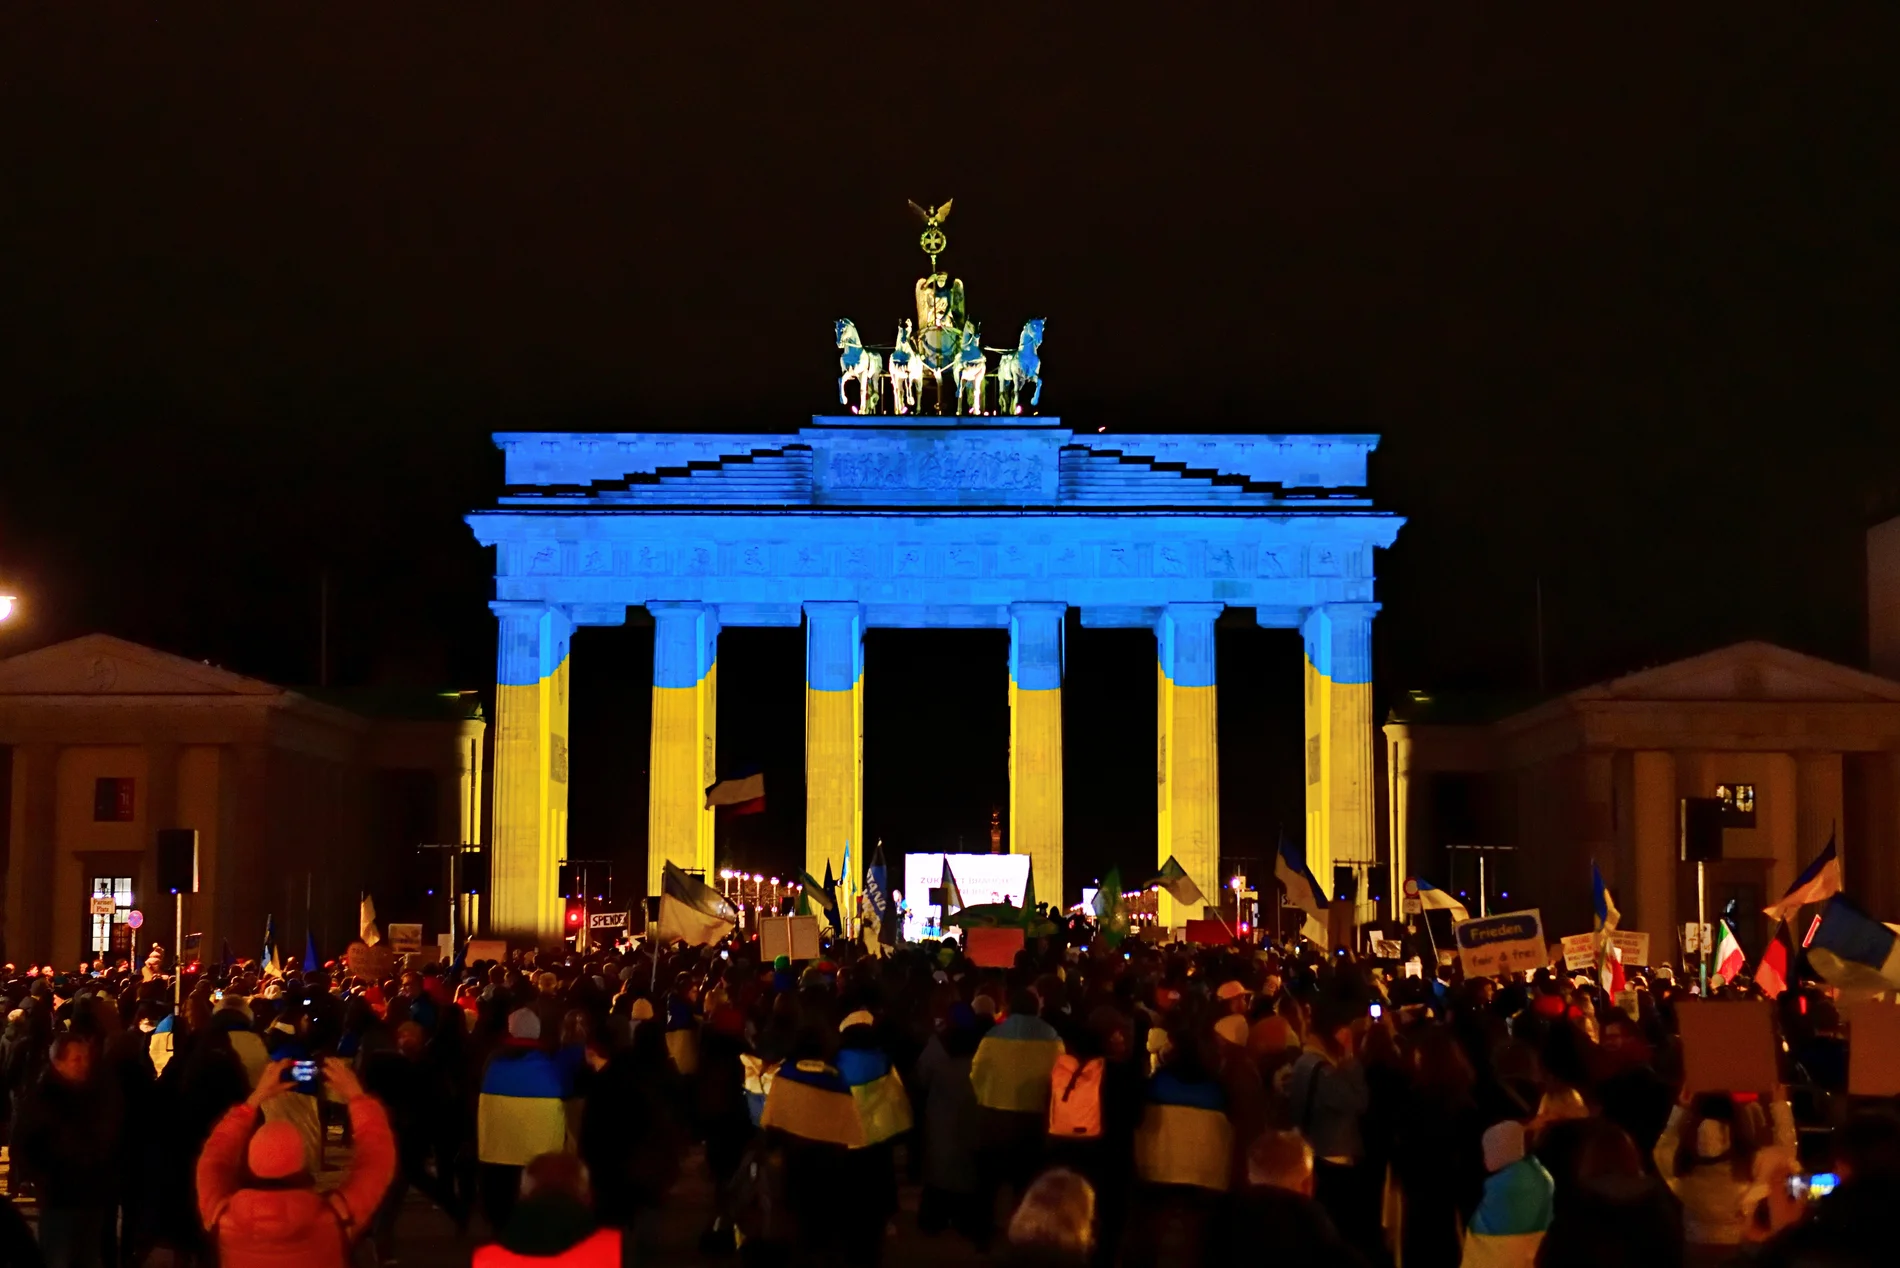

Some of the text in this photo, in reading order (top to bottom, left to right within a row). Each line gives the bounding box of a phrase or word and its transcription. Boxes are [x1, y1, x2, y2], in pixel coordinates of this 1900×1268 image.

[1469, 923, 1524, 940] Frieden
[1472, 955, 1493, 967] fair
[1512, 948, 1536, 960] frei
